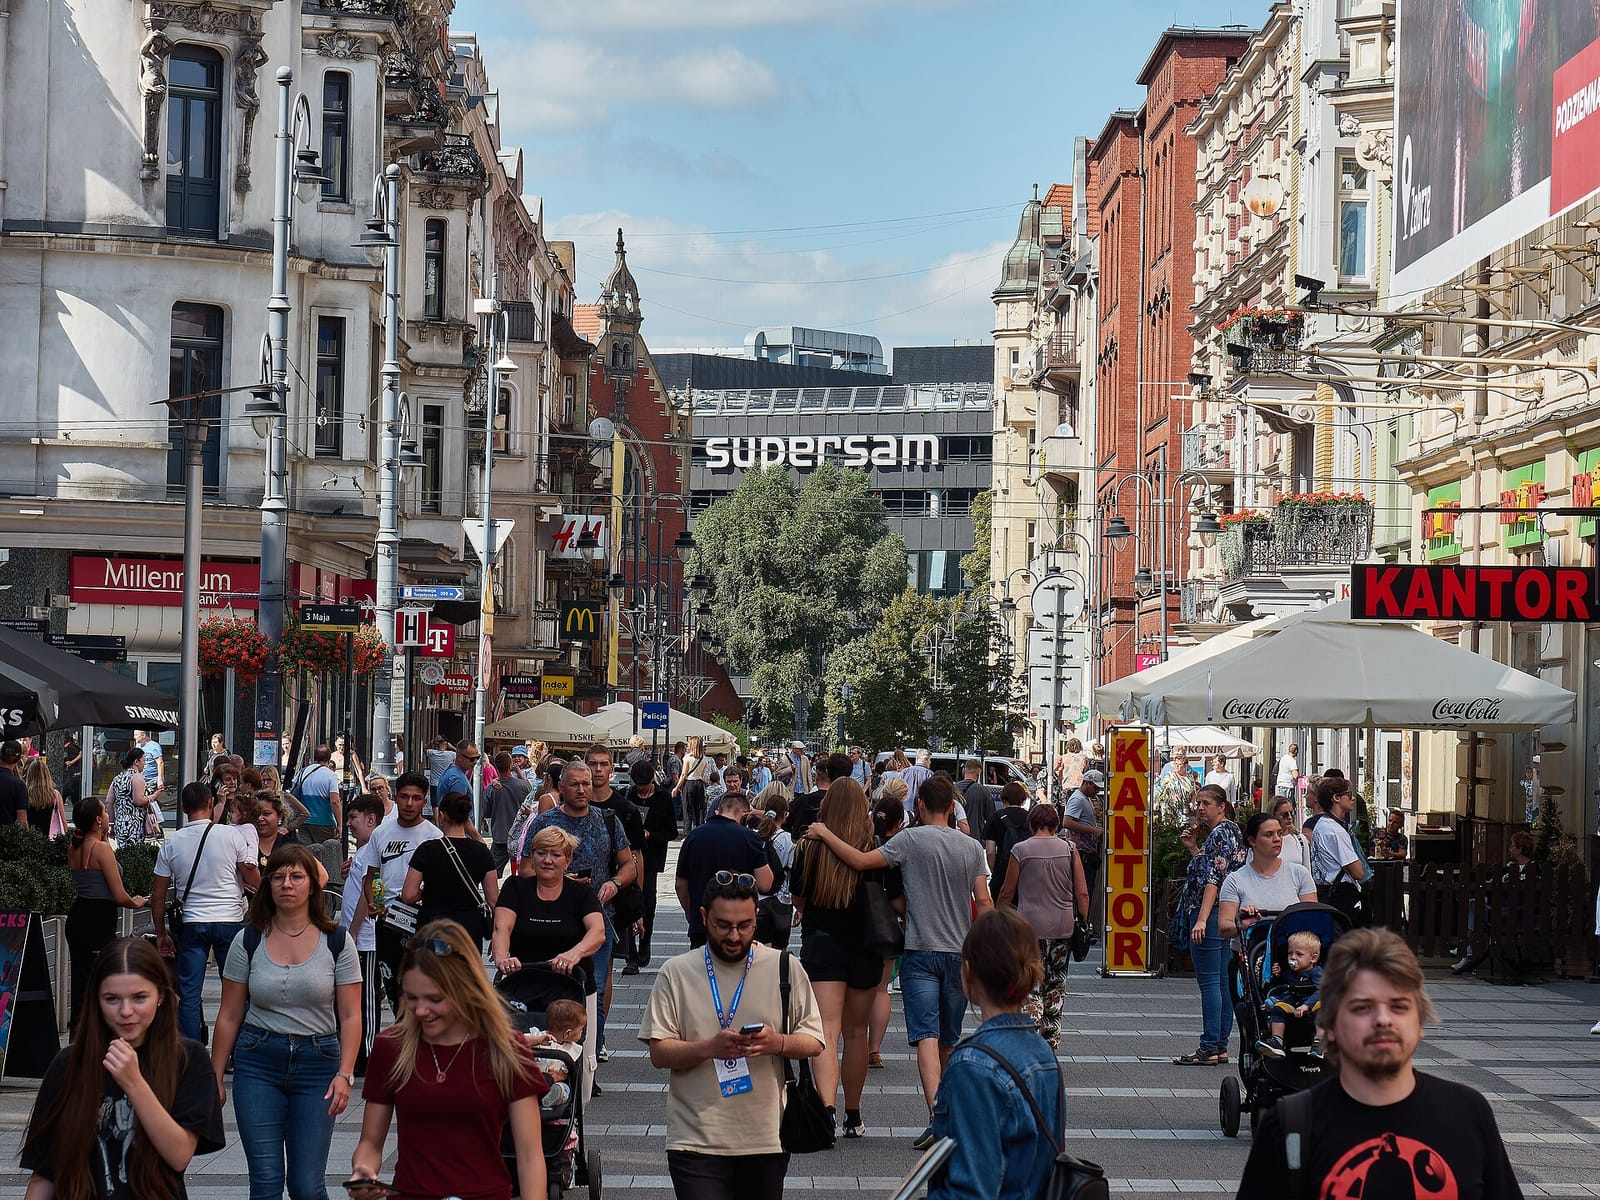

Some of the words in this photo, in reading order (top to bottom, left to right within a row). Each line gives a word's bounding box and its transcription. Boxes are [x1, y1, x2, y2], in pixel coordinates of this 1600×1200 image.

[705, 434, 940, 471] supersam
[104, 557, 231, 591] Millennum
[198, 592, 219, 605] ank
[1364, 567, 1590, 620] KANTOR
[305, 612, 311, 621] 3
[312, 612, 330, 623] Maja
[440, 678, 469, 687] ORLEN
[543, 679, 568, 689] index
[642, 711, 668, 722] Policja
[493, 730, 520, 738] TYSKIE
[568, 733, 596, 742] TYSKIE
[608, 737, 631, 746] TYSKI
[384, 840, 410, 854] NIKE
[1112, 738, 1148, 966] KANTOR
